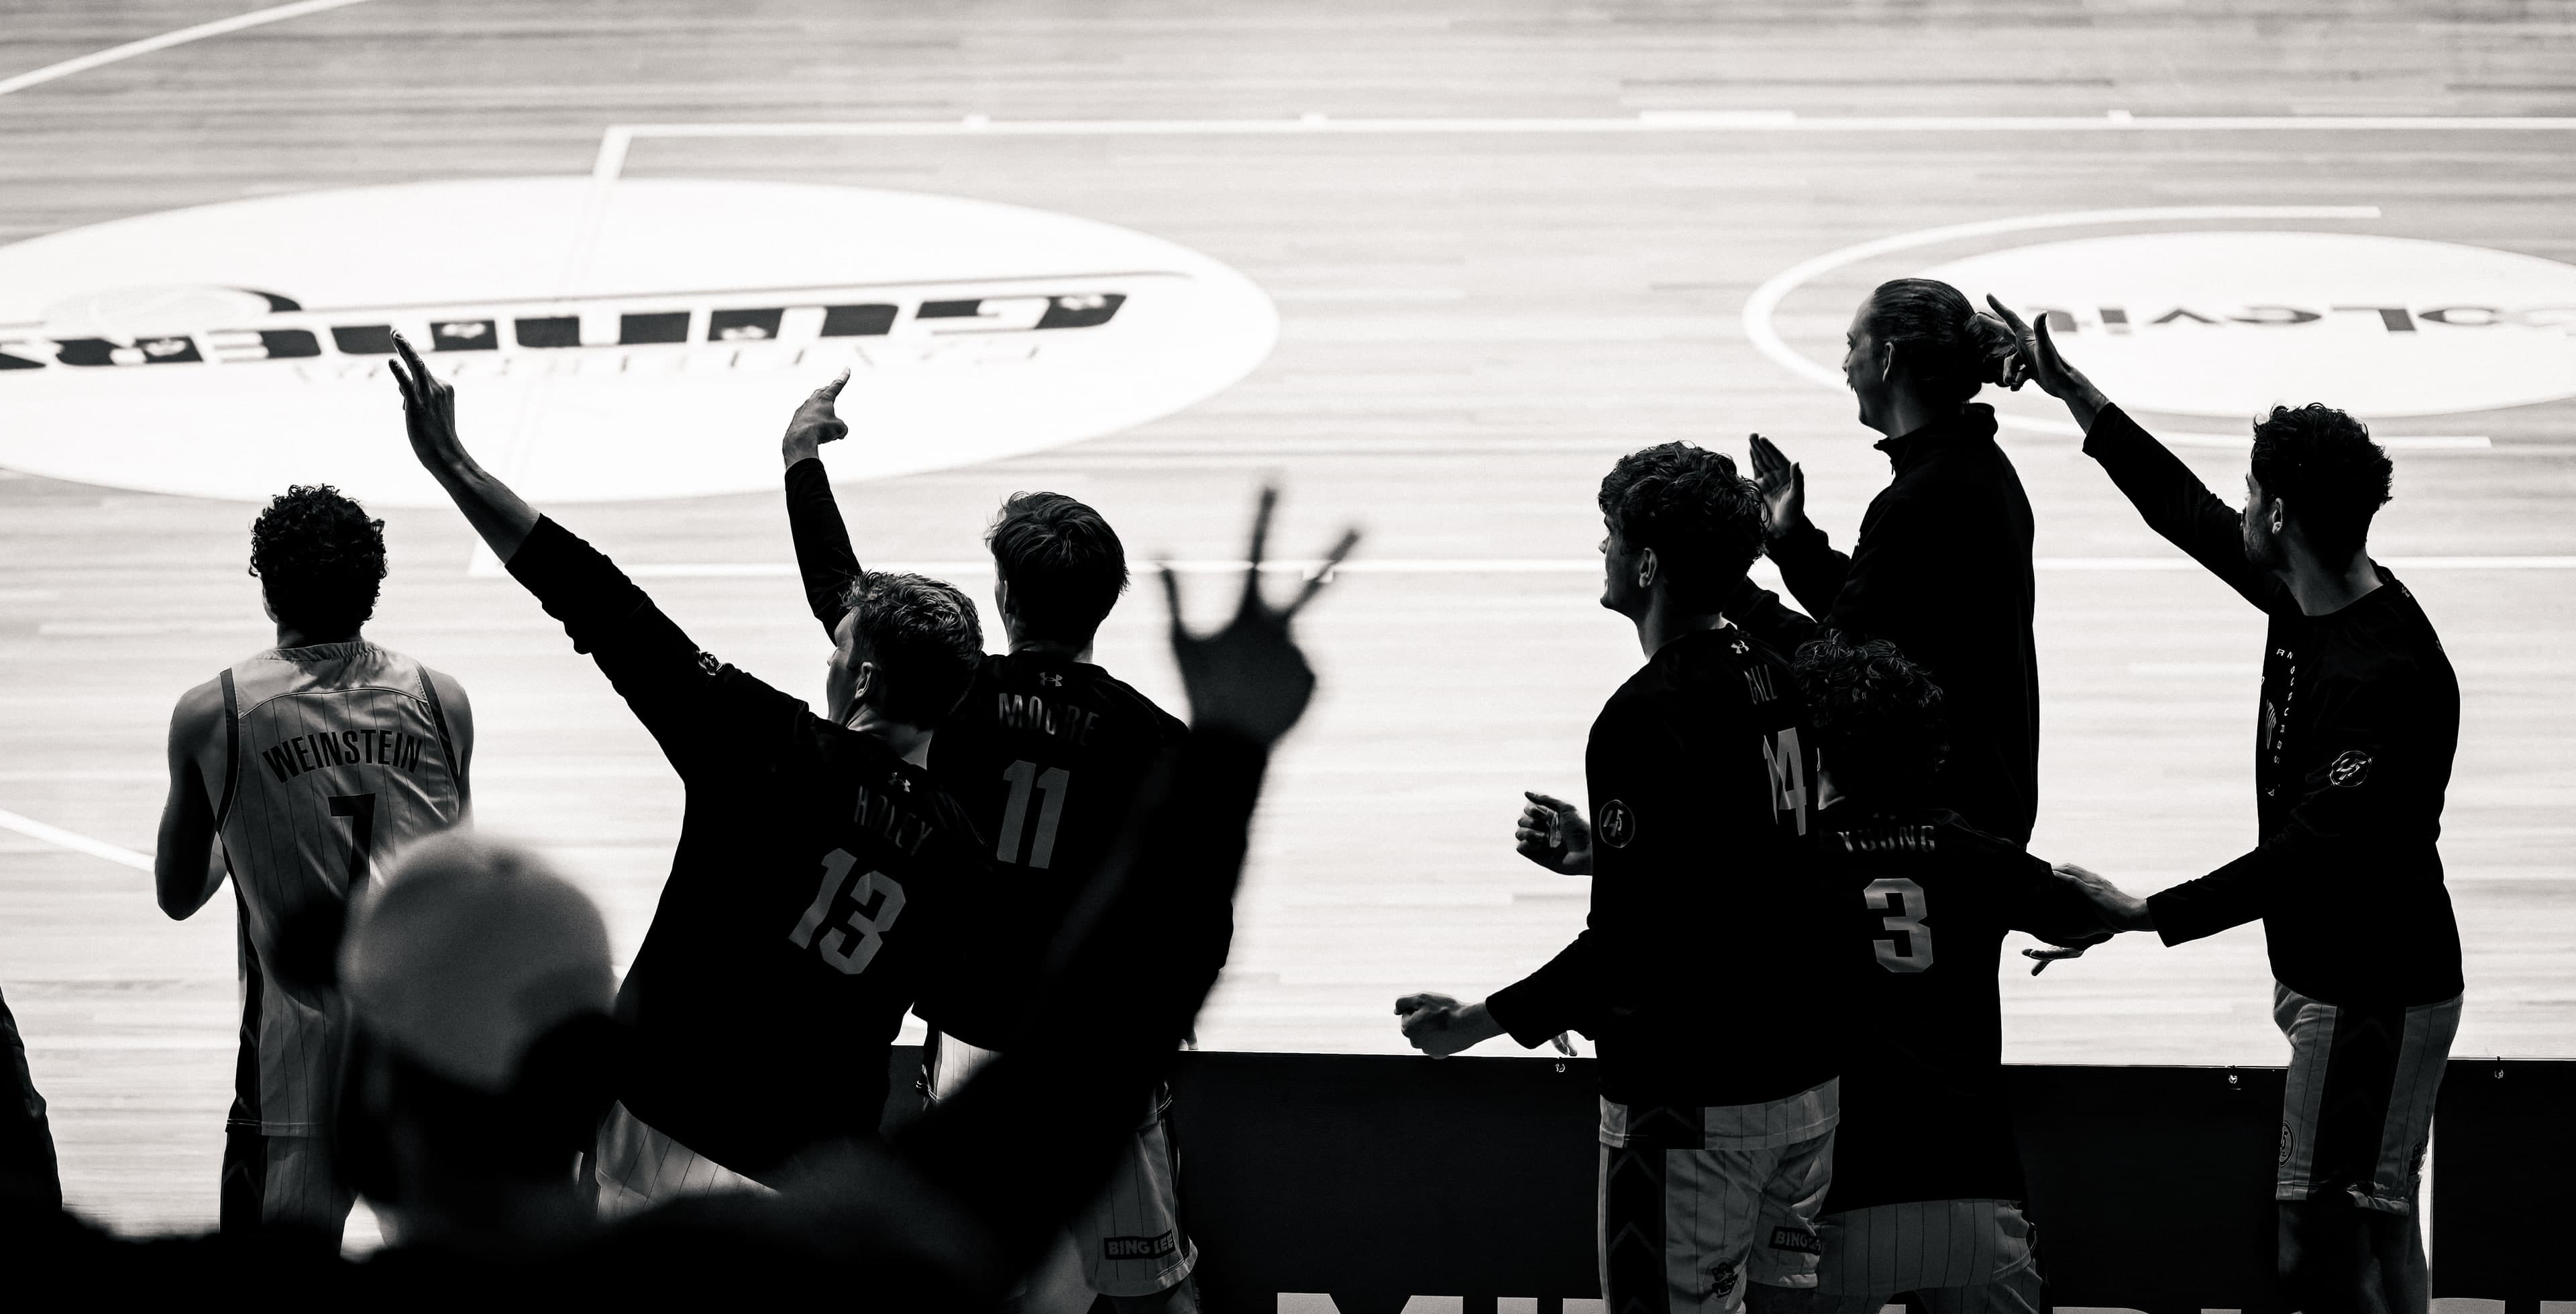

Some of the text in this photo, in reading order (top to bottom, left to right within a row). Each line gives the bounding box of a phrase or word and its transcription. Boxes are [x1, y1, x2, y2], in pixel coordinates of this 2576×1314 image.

[262, 728, 423, 783] WEINSTEIN
[998, 692, 1100, 746] MOORE
[996, 759, 1070, 869] 11
[1762, 726, 1807, 836] 14
[328, 793, 376, 889] 7
[1835, 824, 1936, 853] YOUNG
[788, 847, 907, 975] 13
[1863, 877, 1933, 973] 3
[1108, 1232, 1174, 1256] BING LEE
[1774, 1230, 1809, 1249] BING
